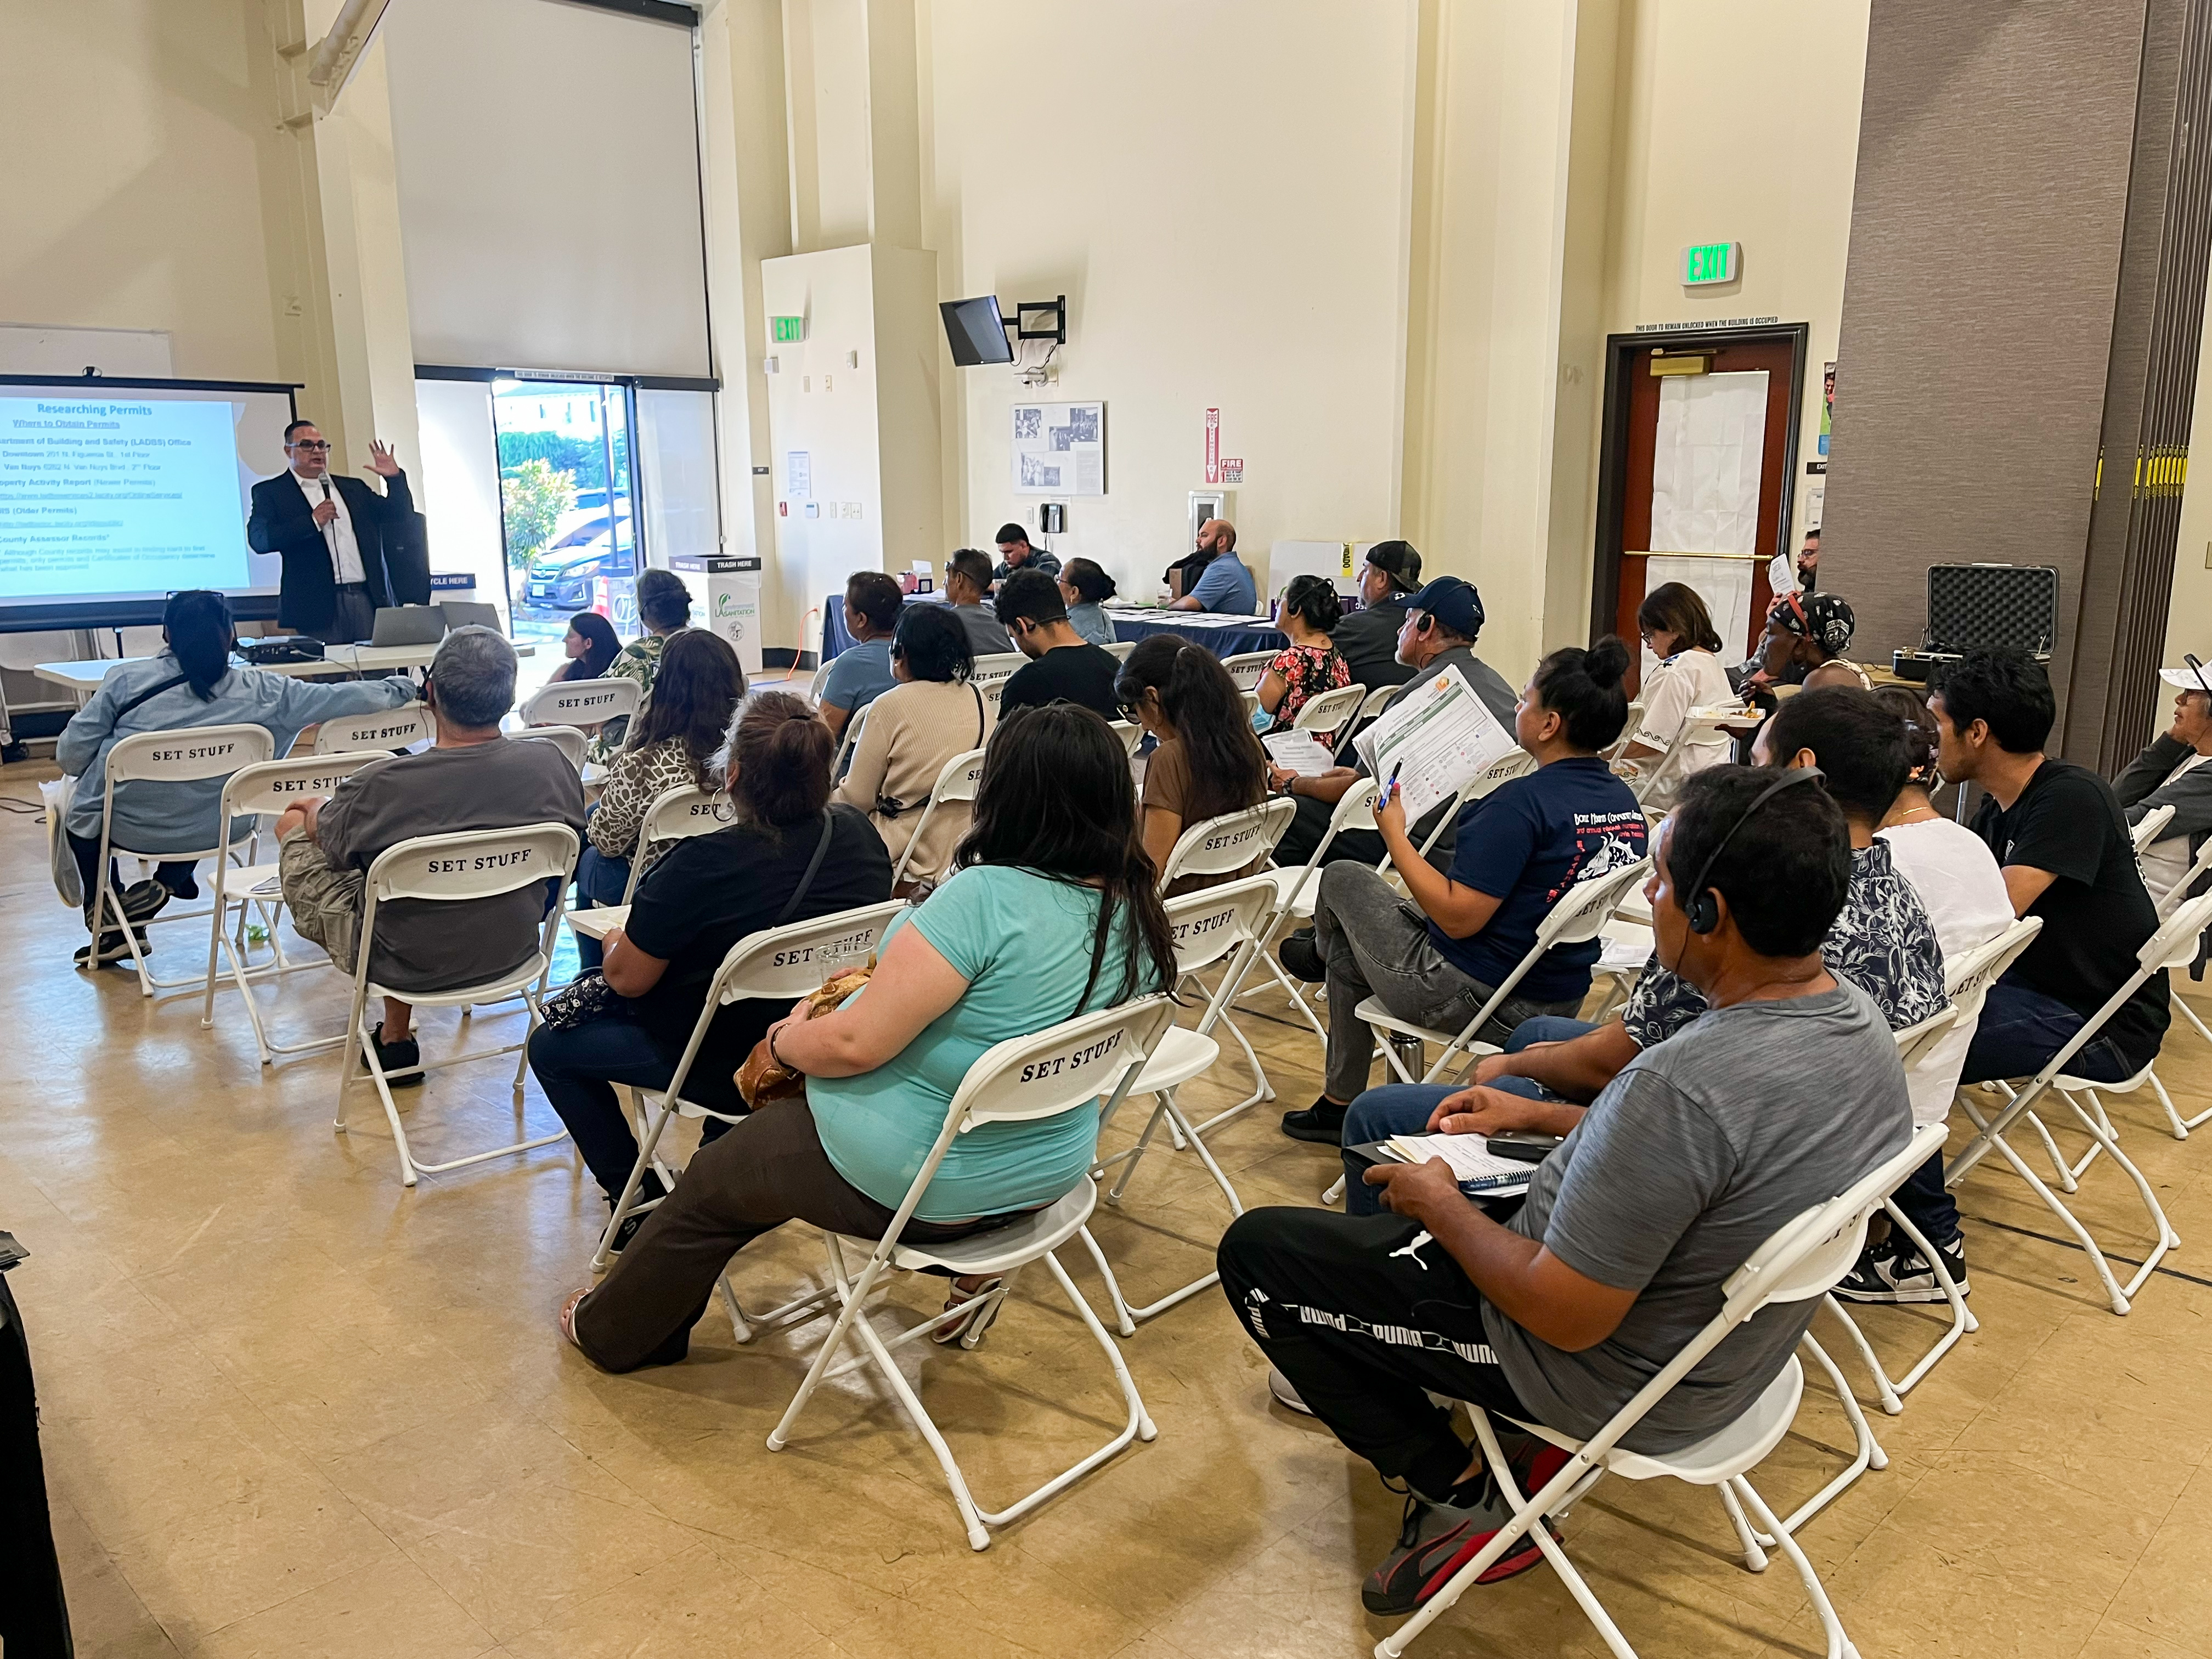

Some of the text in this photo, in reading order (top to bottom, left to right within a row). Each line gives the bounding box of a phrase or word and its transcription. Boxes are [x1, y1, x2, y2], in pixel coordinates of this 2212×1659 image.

[1688, 243, 1730, 281] EXIT
[776, 317, 799, 341] EXIT
[37, 403, 152, 416] Researching Permits
[13, 419, 41, 428] Where
[55, 420, 84, 428] Obtain
[87, 420, 120, 429] Permits
[47, 438, 83, 446] Building
[29, 479, 60, 487] Activity
[42, 506, 77, 515] Permits)
[1231, 665, 1245, 674] SET
[558, 693, 615, 708] SET STUFF
[1318, 704, 1332, 713] SET
[352, 723, 416, 740] SET STUFF
[153, 743, 234, 761] SET STUFF
[1487, 768, 1505, 779] SET
[273, 780, 306, 792] SET
[690, 804, 721, 815] SET
[1205, 823, 1261, 850] SET STUFF
[428, 849, 531, 872] SET STUFF
[1171, 908, 1234, 939] ET STUFF
[774, 948, 813, 966] SET
[1020, 1029, 1124, 1083] SET STUFF
[1300, 1305, 1346, 1331] PUMA
[1372, 1324, 1424, 1348] PUMA
